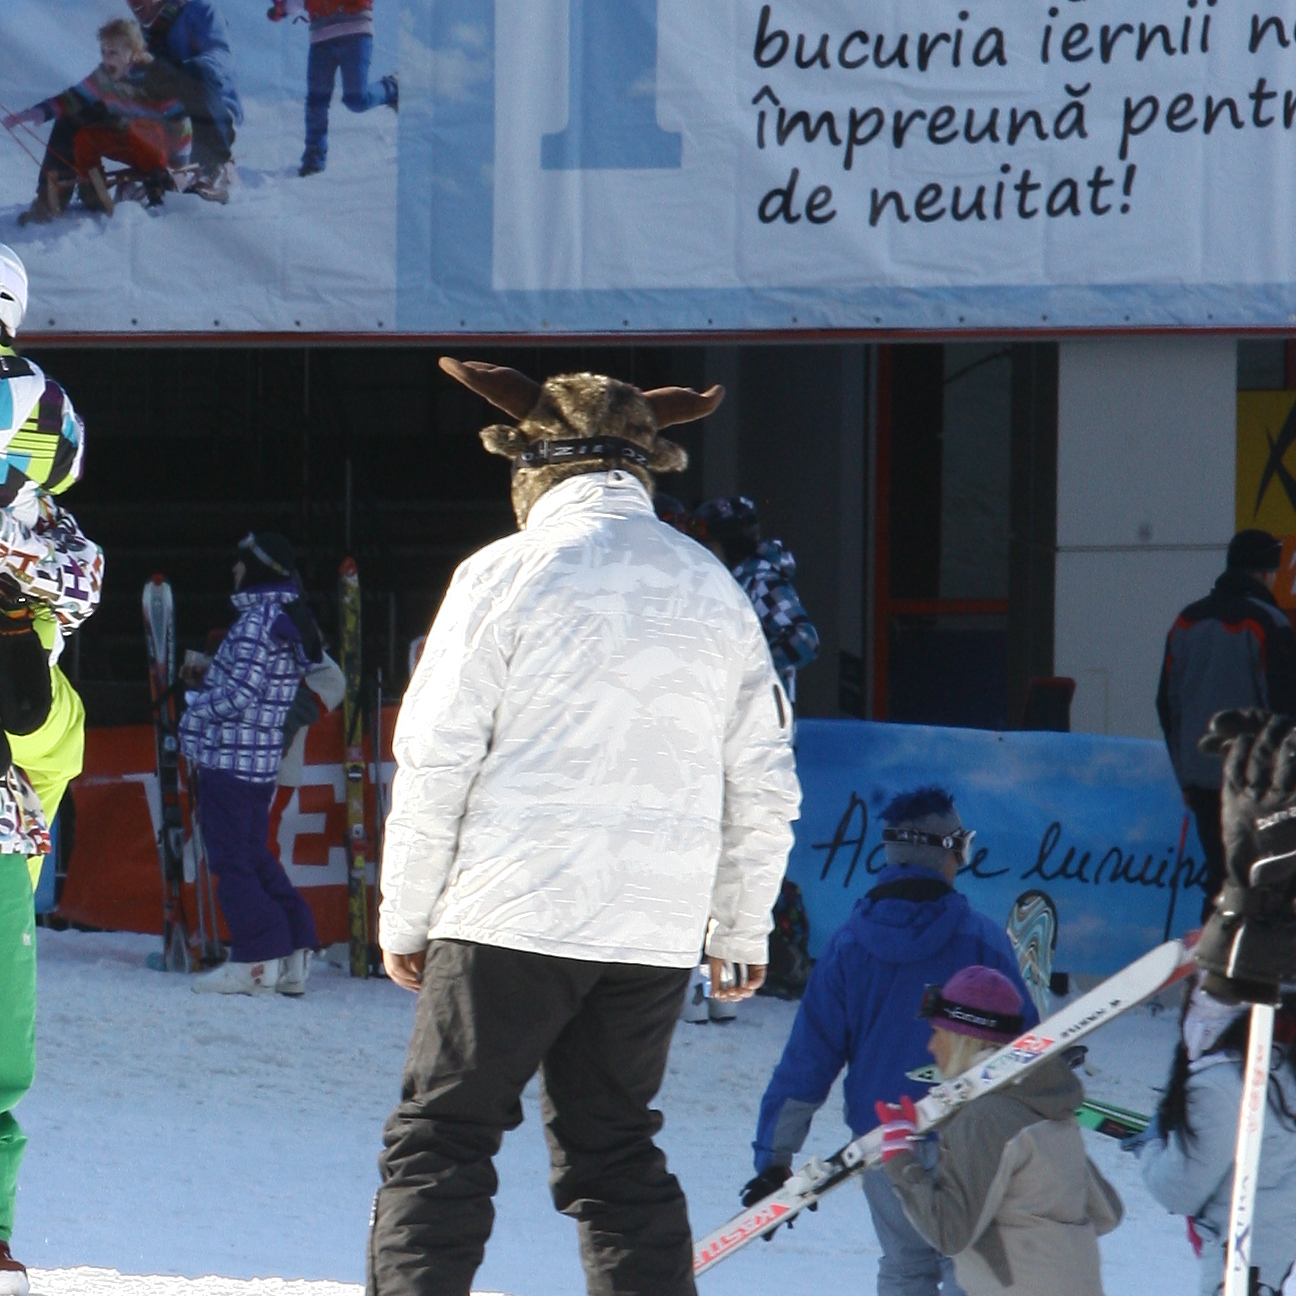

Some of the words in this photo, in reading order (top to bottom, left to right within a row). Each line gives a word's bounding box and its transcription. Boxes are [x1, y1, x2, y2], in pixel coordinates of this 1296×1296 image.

[753, 4, 1008, 73] bucuria
[1247, 13, 1296, 56] n
[751, 83, 1090, 171] împreună
[756, 167, 838, 226] de
[867, 163, 1137, 228] neuitat!
[1018, 821, 1210, 890] lumin
